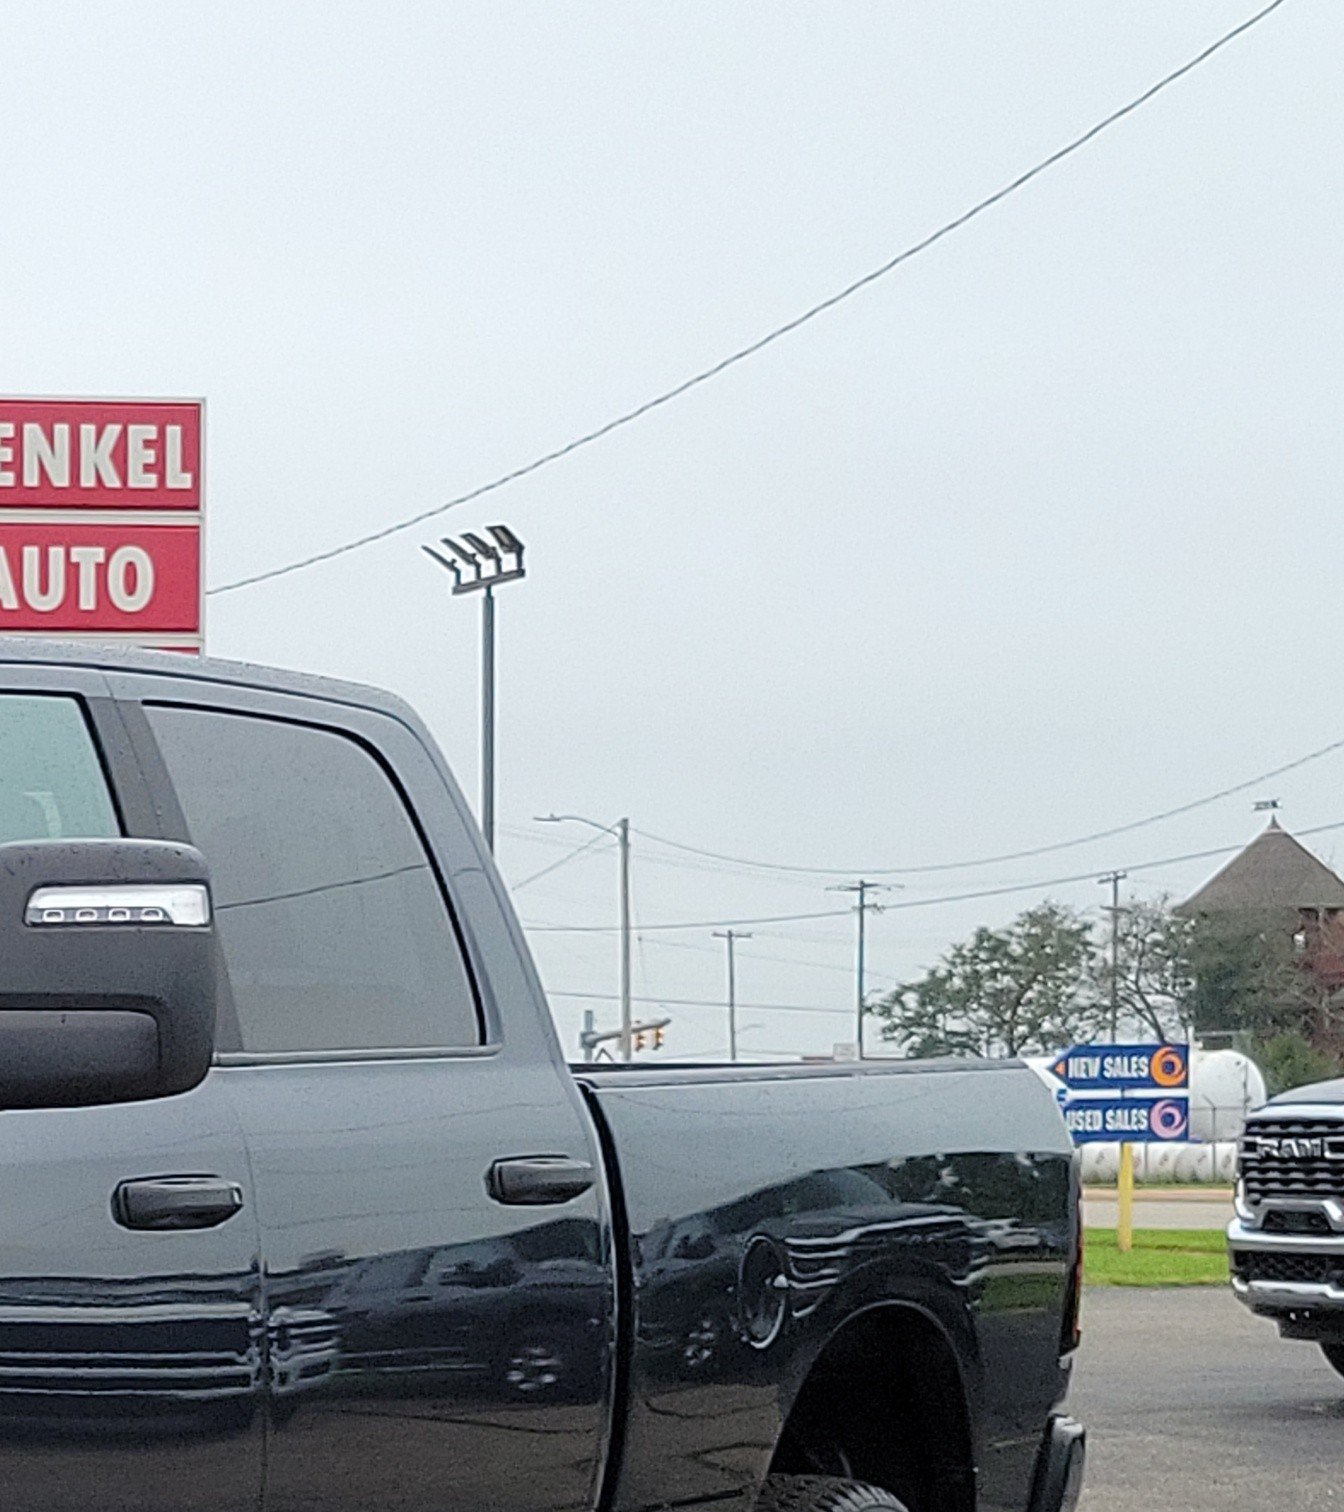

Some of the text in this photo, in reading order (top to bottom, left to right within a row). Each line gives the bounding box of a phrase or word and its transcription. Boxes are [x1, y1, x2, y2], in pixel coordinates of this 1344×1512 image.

[1068, 1055, 1150, 1079] NEW SALES
[1067, 1107, 1149, 1132] USED SALES
[1256, 1136, 1322, 1158] RAM
